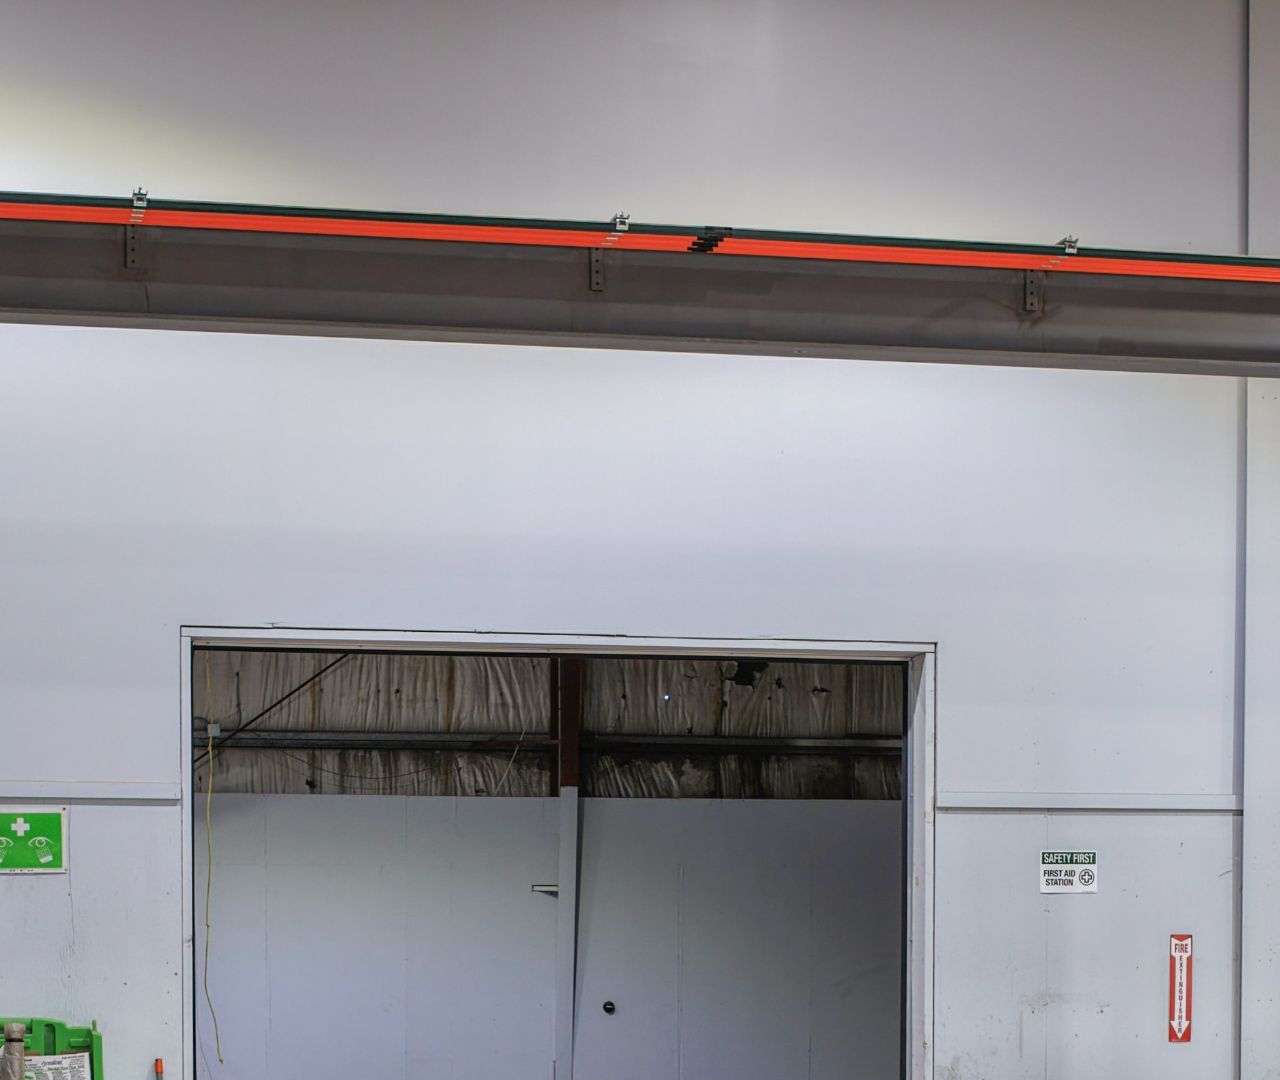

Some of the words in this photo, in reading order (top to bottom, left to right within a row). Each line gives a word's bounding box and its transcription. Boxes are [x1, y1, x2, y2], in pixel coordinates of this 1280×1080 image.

[1044, 853, 1071, 863] SAFETY
[1073, 853, 1094, 863] FIRST
[1043, 869, 1063, 877] FIRST
[1064, 869, 1076, 877] AID
[1045, 878, 1074, 886] STATION
[1174, 943, 1189, 953] FIRE
